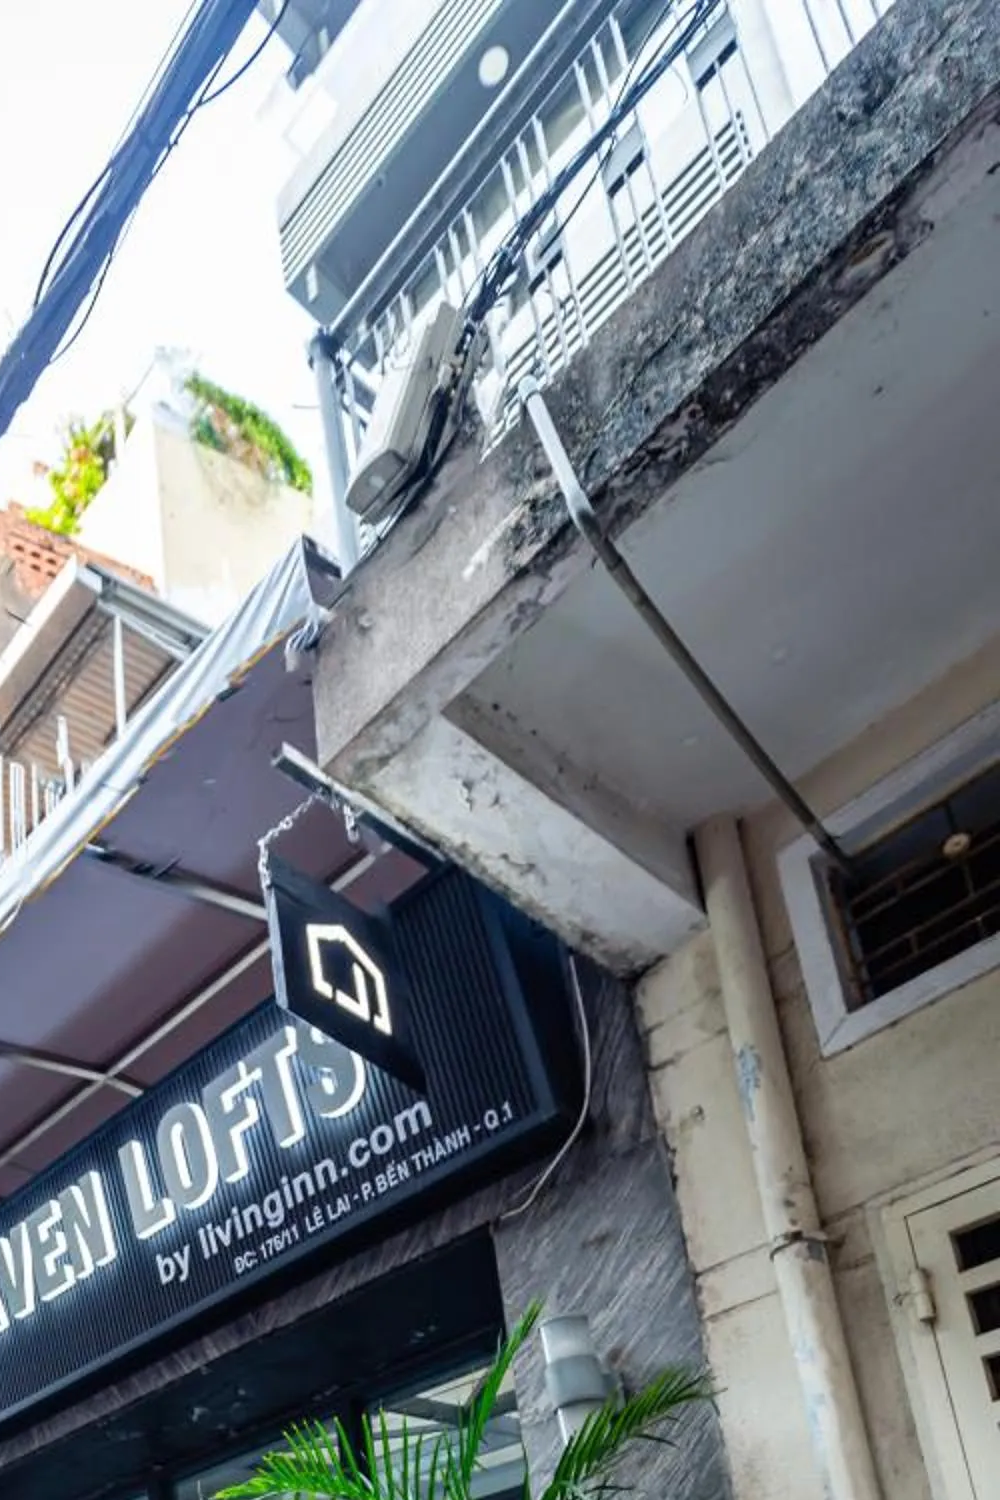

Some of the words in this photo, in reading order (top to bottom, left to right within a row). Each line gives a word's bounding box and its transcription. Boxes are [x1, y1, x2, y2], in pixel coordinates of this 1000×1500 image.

[118, 1024, 366, 1240] LOFTS
[156, 1245, 190, 1285] by
[198, 1101, 433, 1259] livinginn.com
[305, 1206, 324, 1233] LÊ
[327, 1194, 350, 1221] LAI
[412, 1124, 471, 1171] THÀNH
